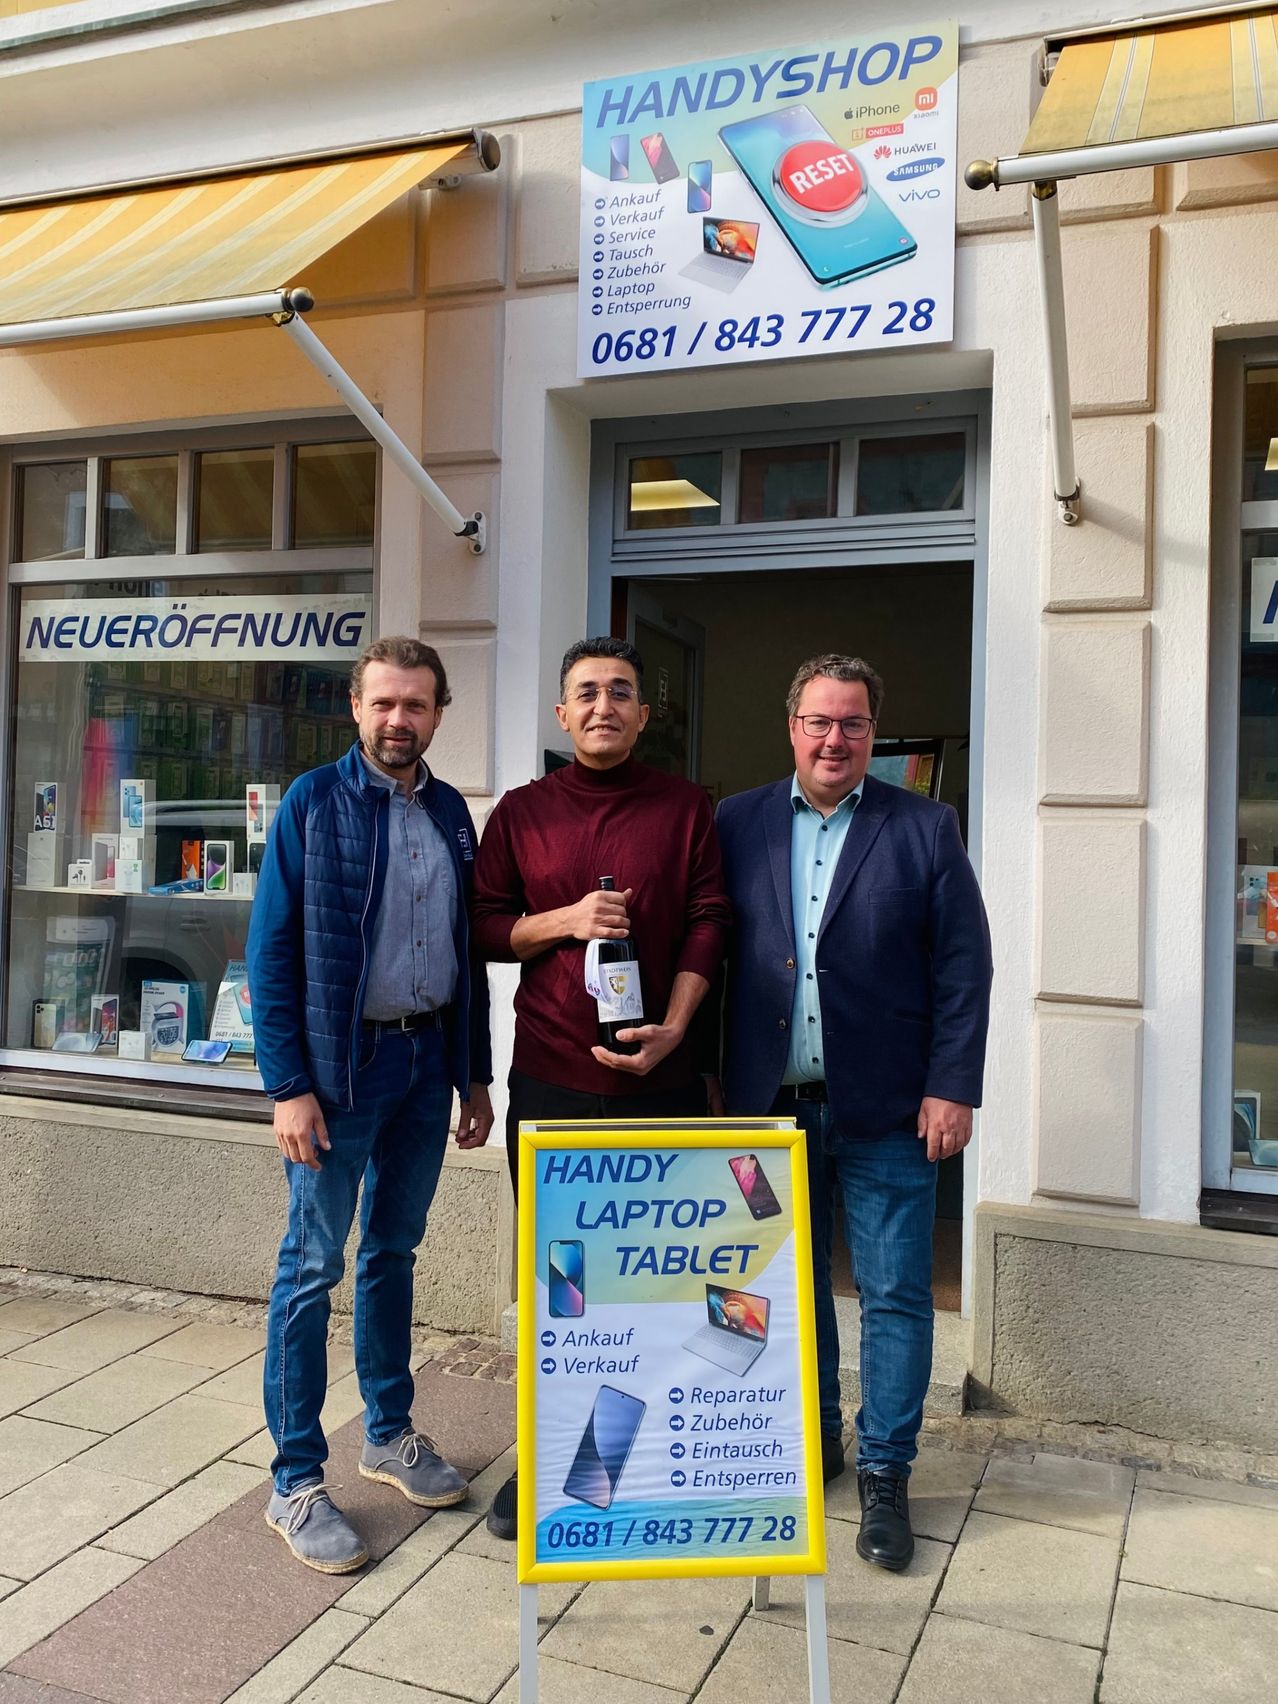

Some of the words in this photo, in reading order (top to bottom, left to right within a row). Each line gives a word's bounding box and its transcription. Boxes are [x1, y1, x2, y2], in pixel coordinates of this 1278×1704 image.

[596, 35, 944, 128] HANDYSHOP
[856, 104, 900, 118] iPhone
[867, 125, 902, 136] ONEPLUS
[894, 143, 937, 155] HUAWEI
[789, 153, 855, 194] RESET
[893, 163, 938, 176] SAMSUNG
[609, 189, 662, 209] Ankauf
[898, 188, 941, 202] vivo
[610, 206, 665, 226] Verkauf
[608, 228, 656, 244] Service
[609, 244, 654, 261] Tausch
[607, 262, 666, 279] Zubehör
[607, 282, 655, 298] Laptop
[607, 296, 691, 315] Entsperrung
[592, 325, 677, 364] 0681
[687, 322, 707, 355] /
[714, 313, 785, 352] 843
[798, 304, 872, 343] 777
[881, 298, 936, 335] 28
[26, 603, 366, 648] NEUERÖFFNUNG
[543, 1153, 679, 1184] HANDY
[575, 1199, 727, 1230] LAPTOP
[616, 1244, 759, 1276] TABLET
[562, 1328, 634, 1347] Ankauf
[564, 1354, 640, 1375] Verkauf
[690, 1386, 787, 1408] Reparatur
[690, 1413, 773, 1432] Zubehör
[691, 1438, 783, 1460] Eintausch
[692, 1468, 797, 1492] Entsperren
[547, 1520, 615, 1549] 0681
[622, 1519, 637, 1546] /
[642, 1518, 693, 1545] 843
[703, 1517, 753, 1543] 777
[761, 1515, 797, 1541] 28
